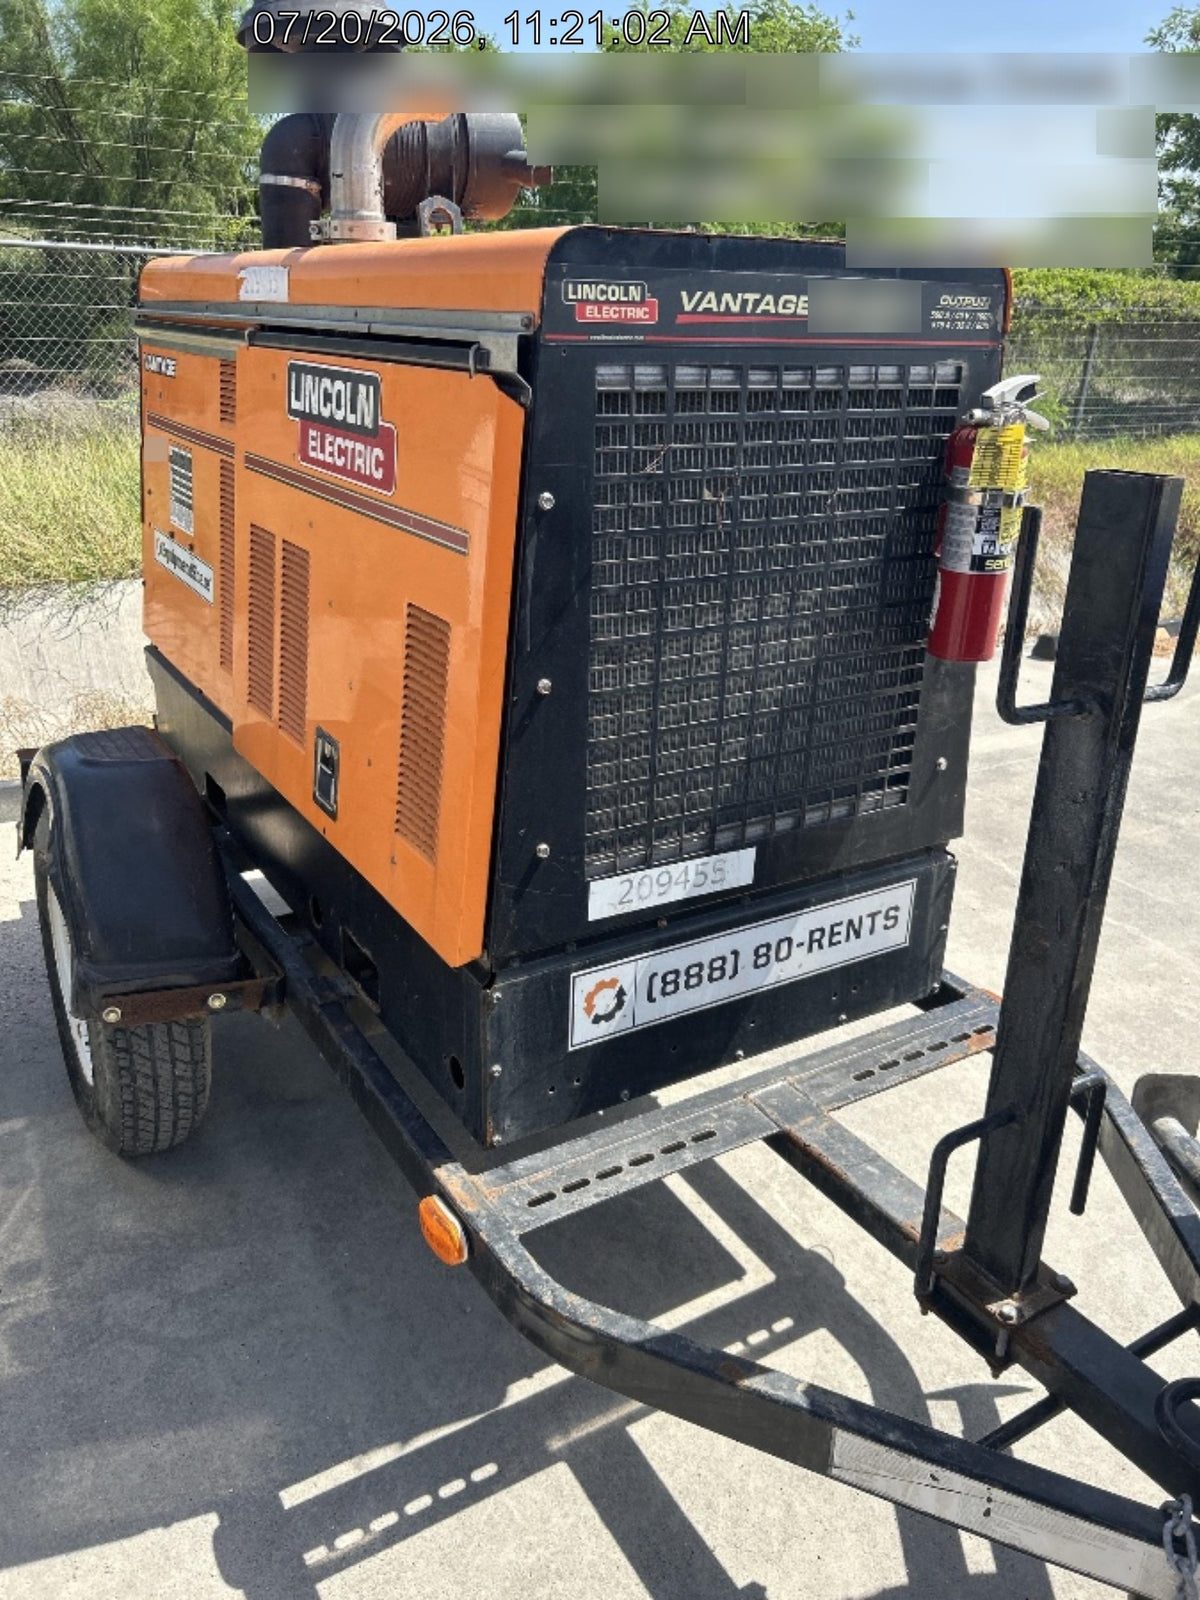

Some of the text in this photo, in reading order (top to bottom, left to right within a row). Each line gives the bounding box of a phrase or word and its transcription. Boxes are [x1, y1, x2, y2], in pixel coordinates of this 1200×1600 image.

[568, 283, 641, 302] LINCOLN
[585, 305, 650, 319] ELECTRIC
[680, 290, 809, 316] VANTAGE
[290, 371, 375, 430] LINCOLN
[308, 428, 385, 481] ELECTRIC
[646, 904, 901, 1003] (888) 80-RENTS
